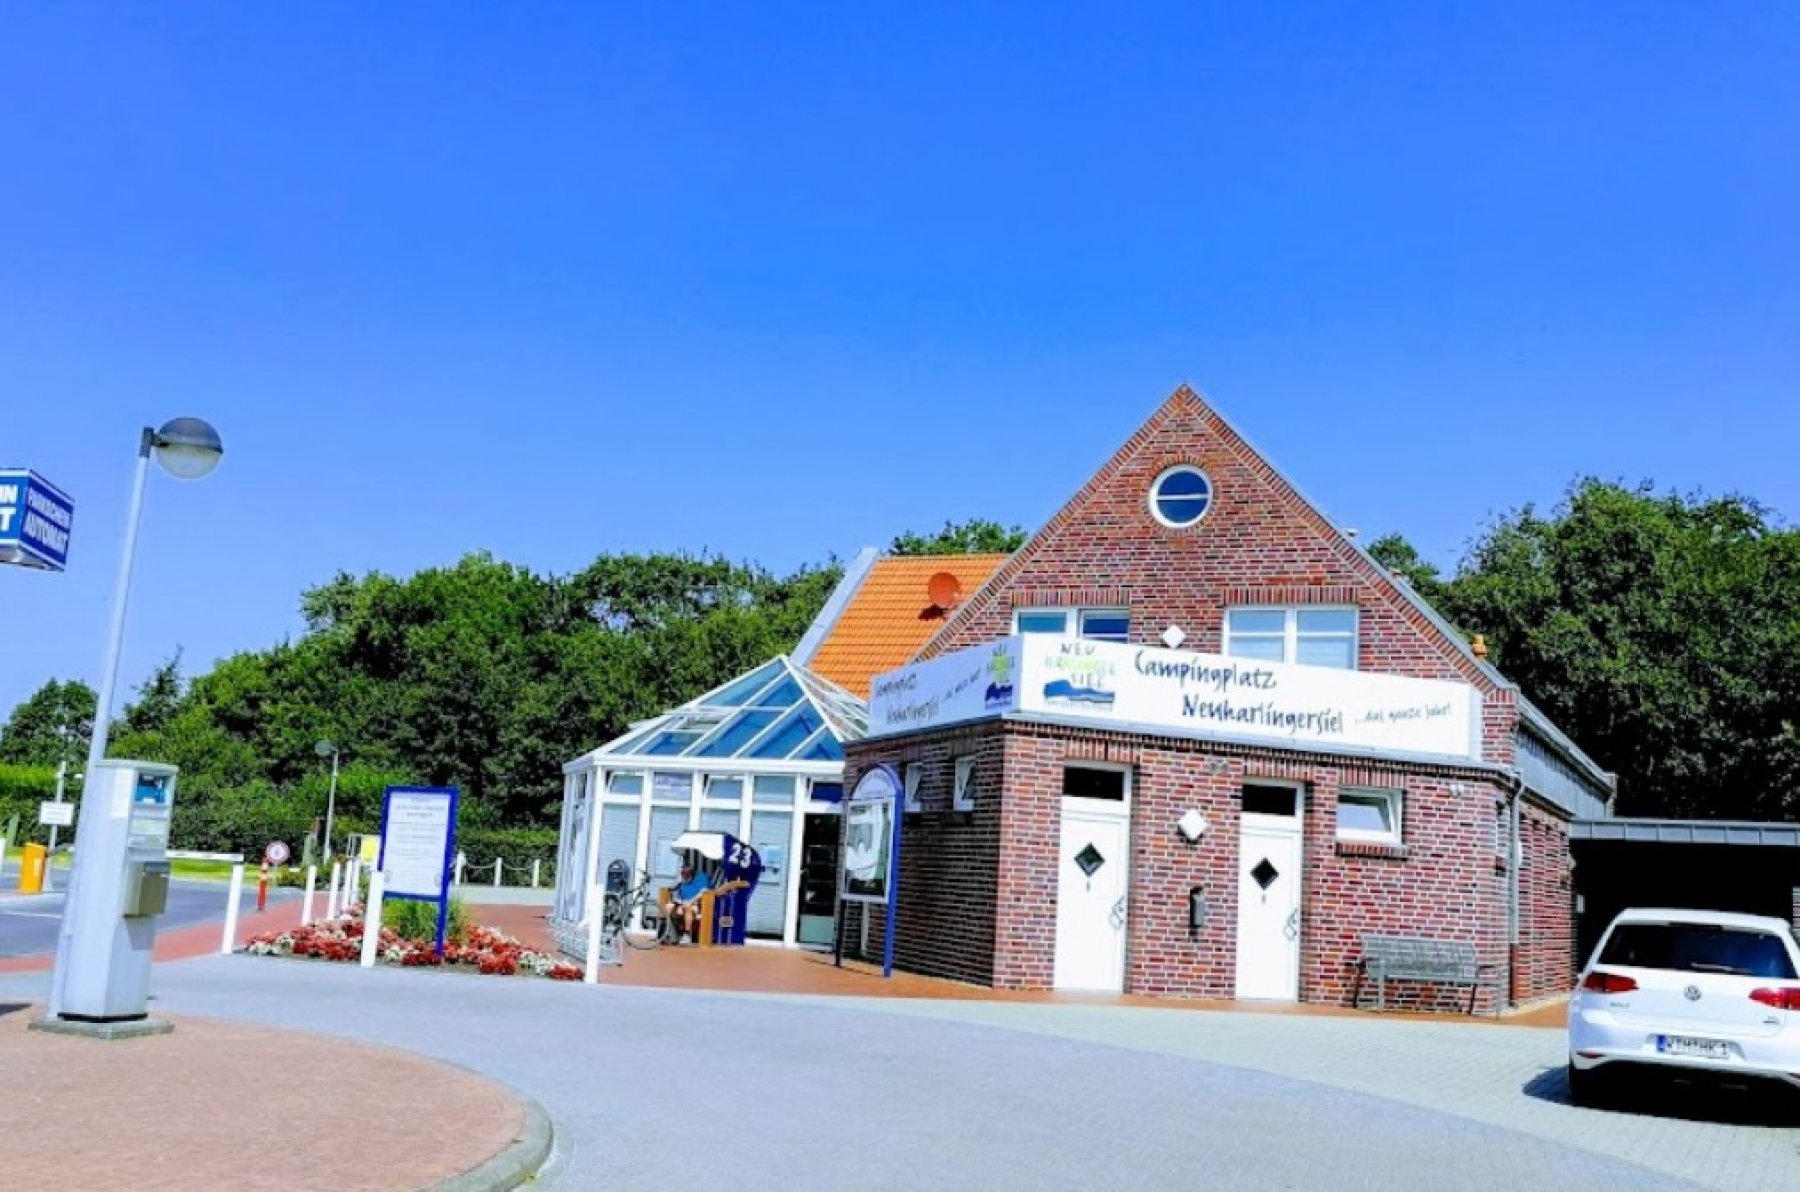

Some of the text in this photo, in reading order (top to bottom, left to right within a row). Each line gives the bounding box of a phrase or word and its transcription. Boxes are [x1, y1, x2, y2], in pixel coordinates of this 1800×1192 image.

[1060, 643, 1097, 656] NEU
[1134, 650, 1277, 693] Campingplatz
[728, 842, 752, 869] 23
